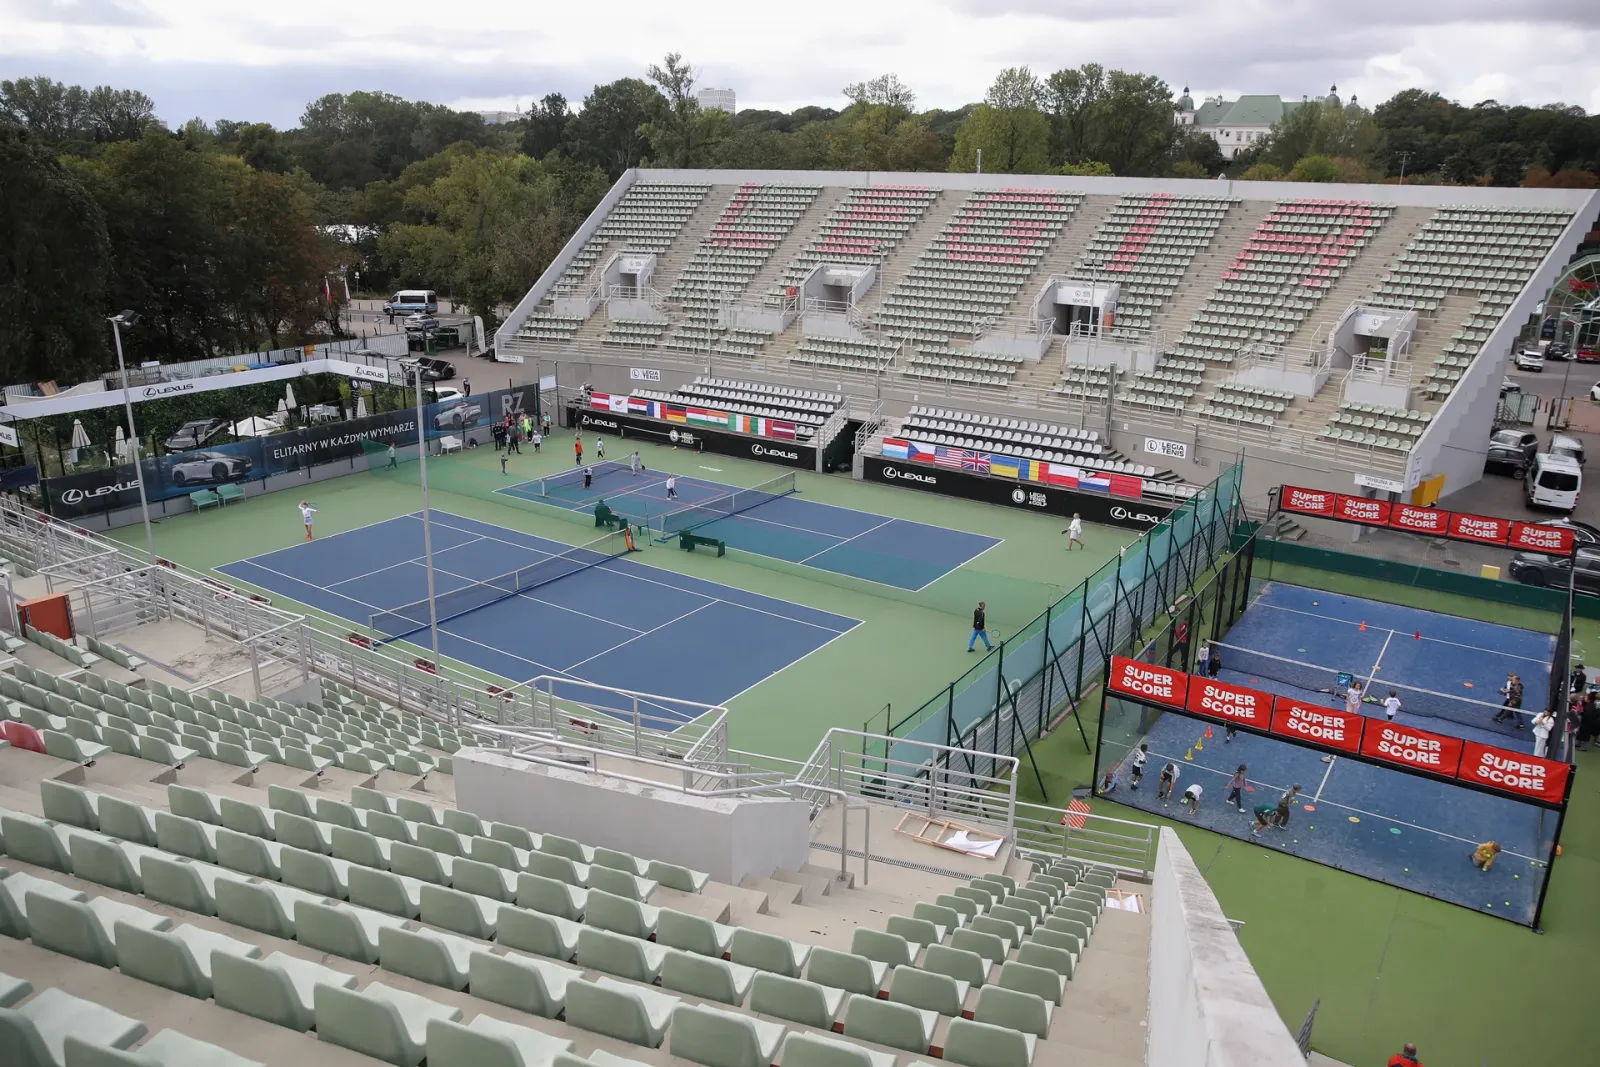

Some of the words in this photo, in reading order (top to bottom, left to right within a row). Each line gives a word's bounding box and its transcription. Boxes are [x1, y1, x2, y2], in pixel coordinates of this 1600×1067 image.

[362, 370, 384, 379] LEXUS
[157, 383, 194, 394] LEXUS
[502, 392, 525, 416] RZ
[590, 419, 617, 428] LEXUS
[274, 441, 319, 459] ELITARNY
[319, 439, 330, 449] W
[331, 431, 369, 446] KAŻDYM
[371, 422, 415, 439] WYMIARZE
[1161, 442, 1184, 451] LEGIA
[764, 449, 798, 460] LEXUS
[1162, 448, 1184, 457] TENIS
[897, 471, 937, 484] LEXUS
[1292, 490, 1325, 502] SUPER
[1290, 498, 1325, 510] SCORE
[1346, 500, 1380, 511] SUPER
[1344, 506, 1380, 519] SCORE
[1402, 508, 1437, 520] SUPER
[1400, 516, 1437, 529] SCORE
[1460, 518, 1498, 530] SUPER
[1458, 526, 1498, 538] SCORE
[1522, 526, 1561, 539] SUPER
[1520, 535, 1561, 548] SCORE
[1124, 665, 1173, 685] SUPER
[1122, 676, 1172, 698] SCORE
[1204, 685, 1256, 706] SUPER
[1201, 696, 1255, 719] SCORE
[1290, 707, 1345, 729] SUPER
[1287, 718, 1344, 741] SCORE
[1381, 729, 1441, 752] SUPER
[1378, 740, 1441, 765] SCORE
[1480, 753, 1546, 778] SUPER
[1476, 765, 1545, 791] SCORE
